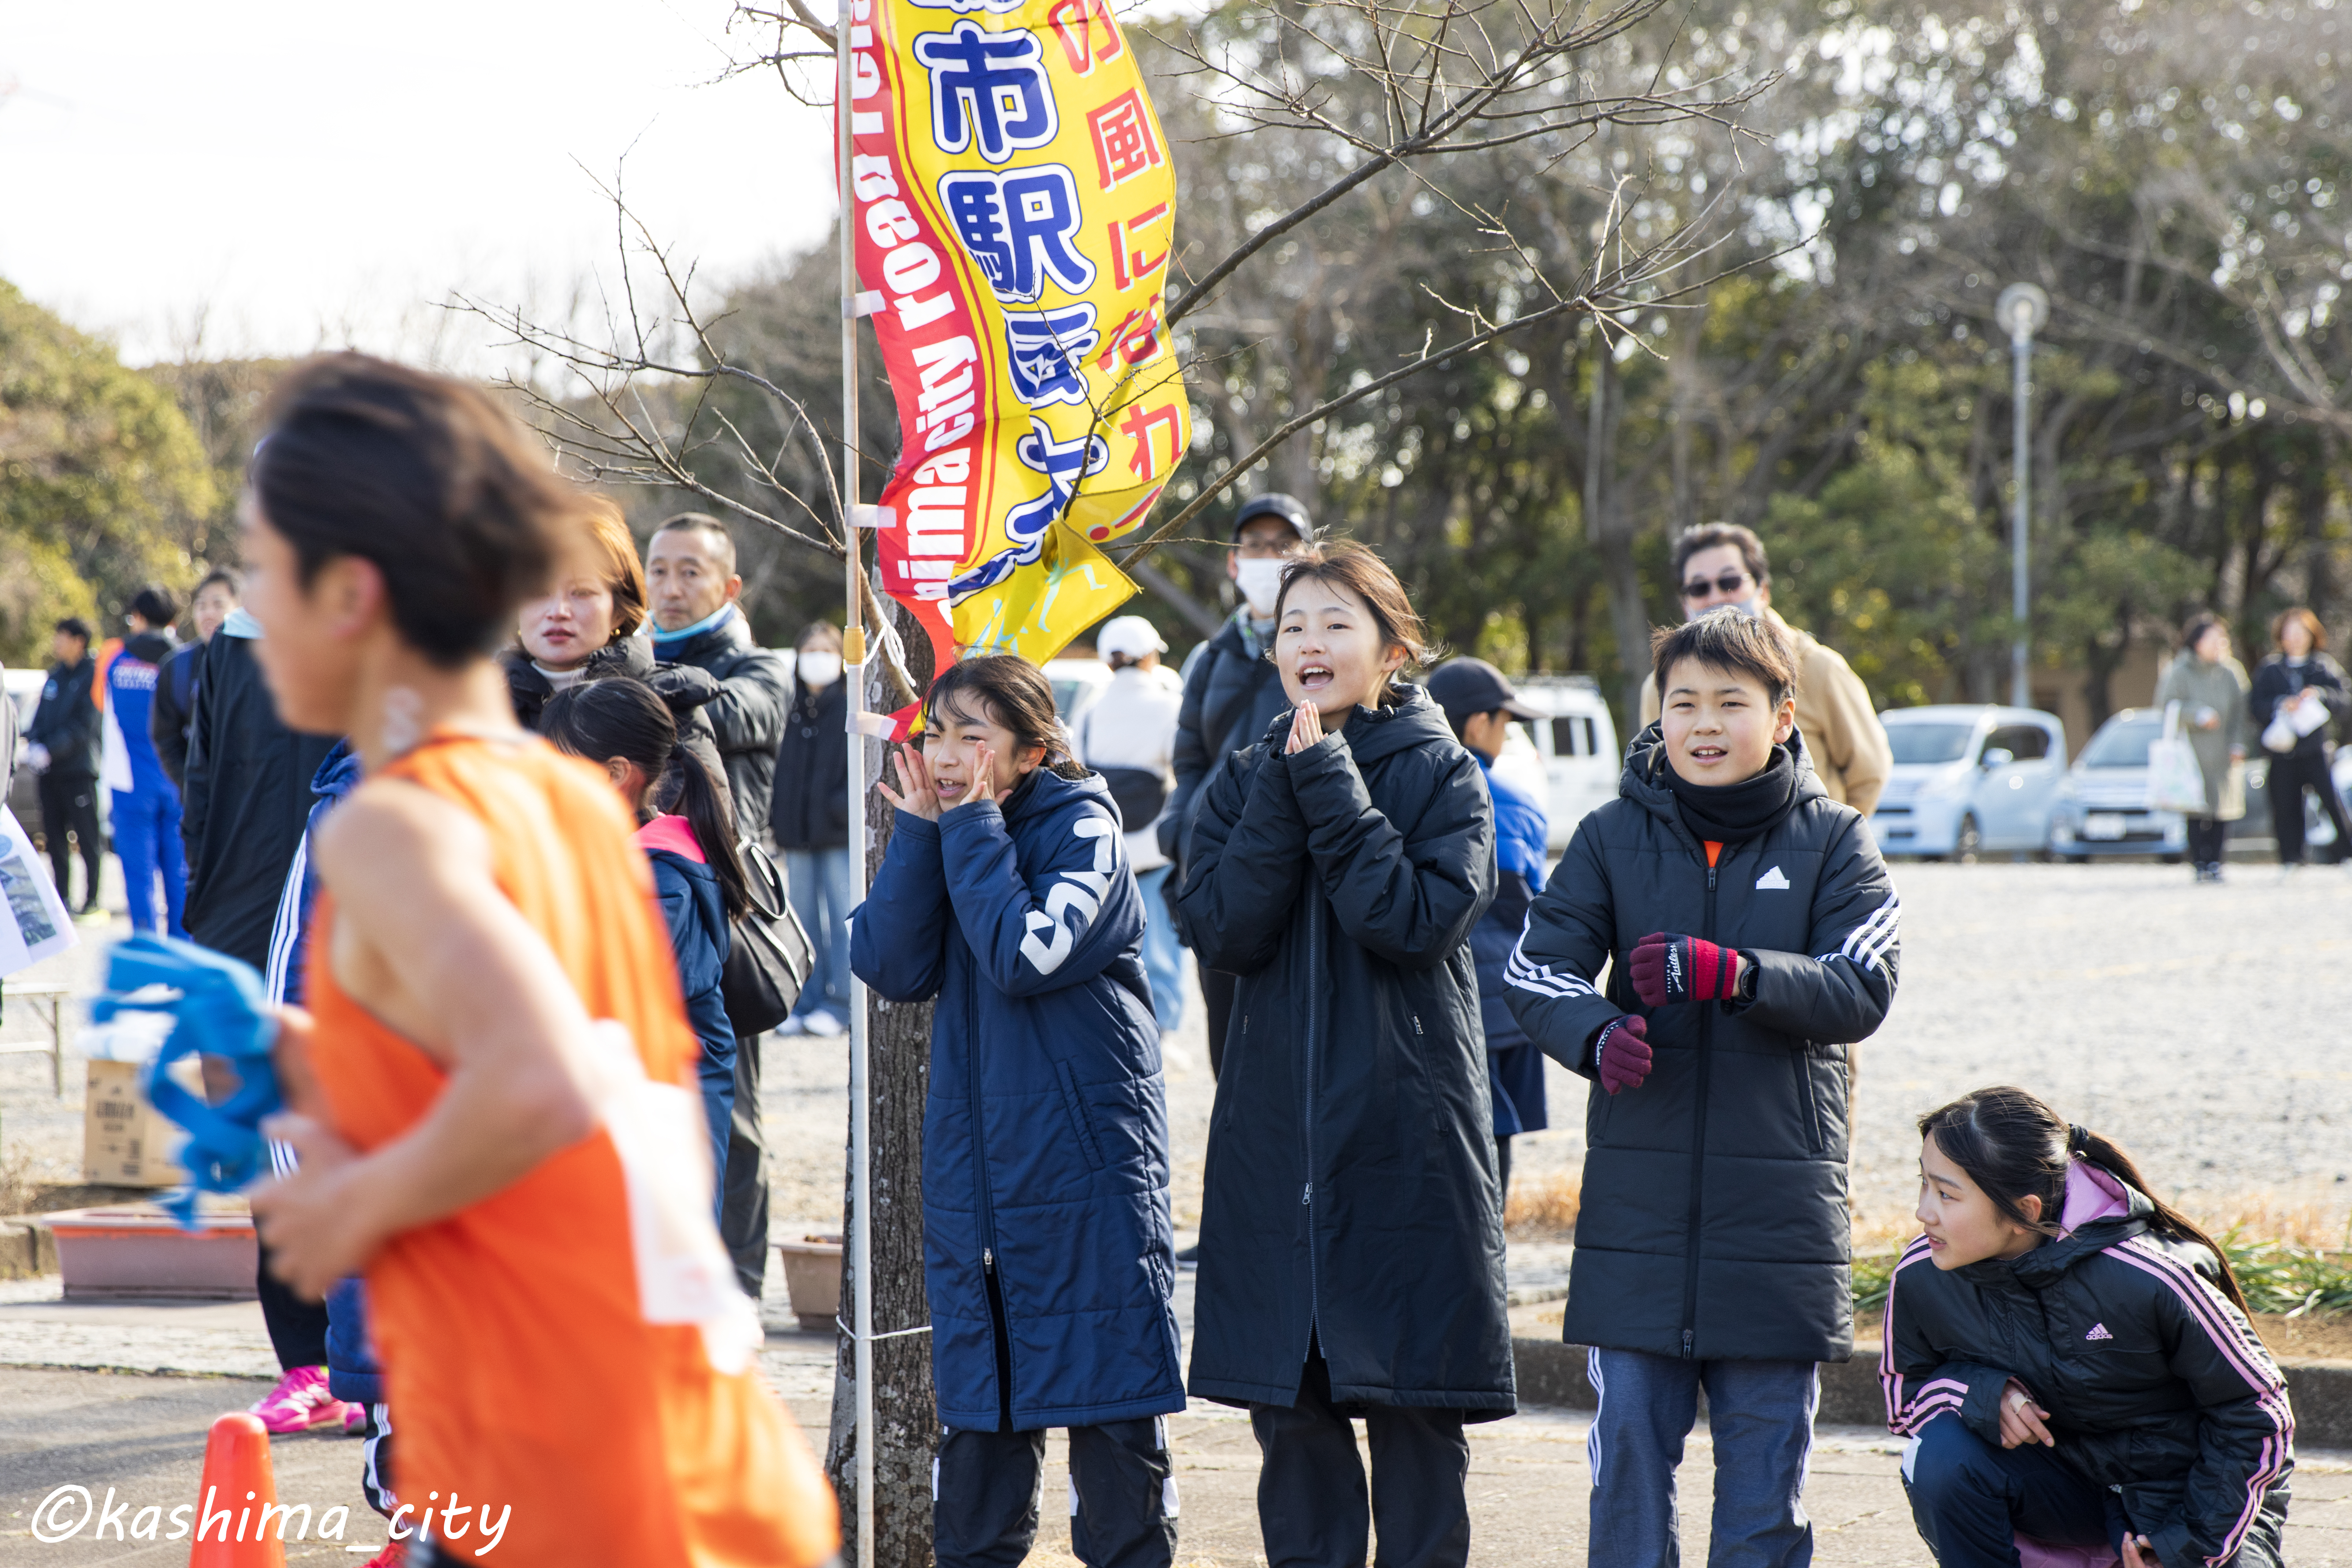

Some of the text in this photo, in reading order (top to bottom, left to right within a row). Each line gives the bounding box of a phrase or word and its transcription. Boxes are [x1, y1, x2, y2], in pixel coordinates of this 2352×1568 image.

[853, 153, 956, 332] road
[911, 335, 978, 452] city
[1758, 879, 1788, 887] adidas
